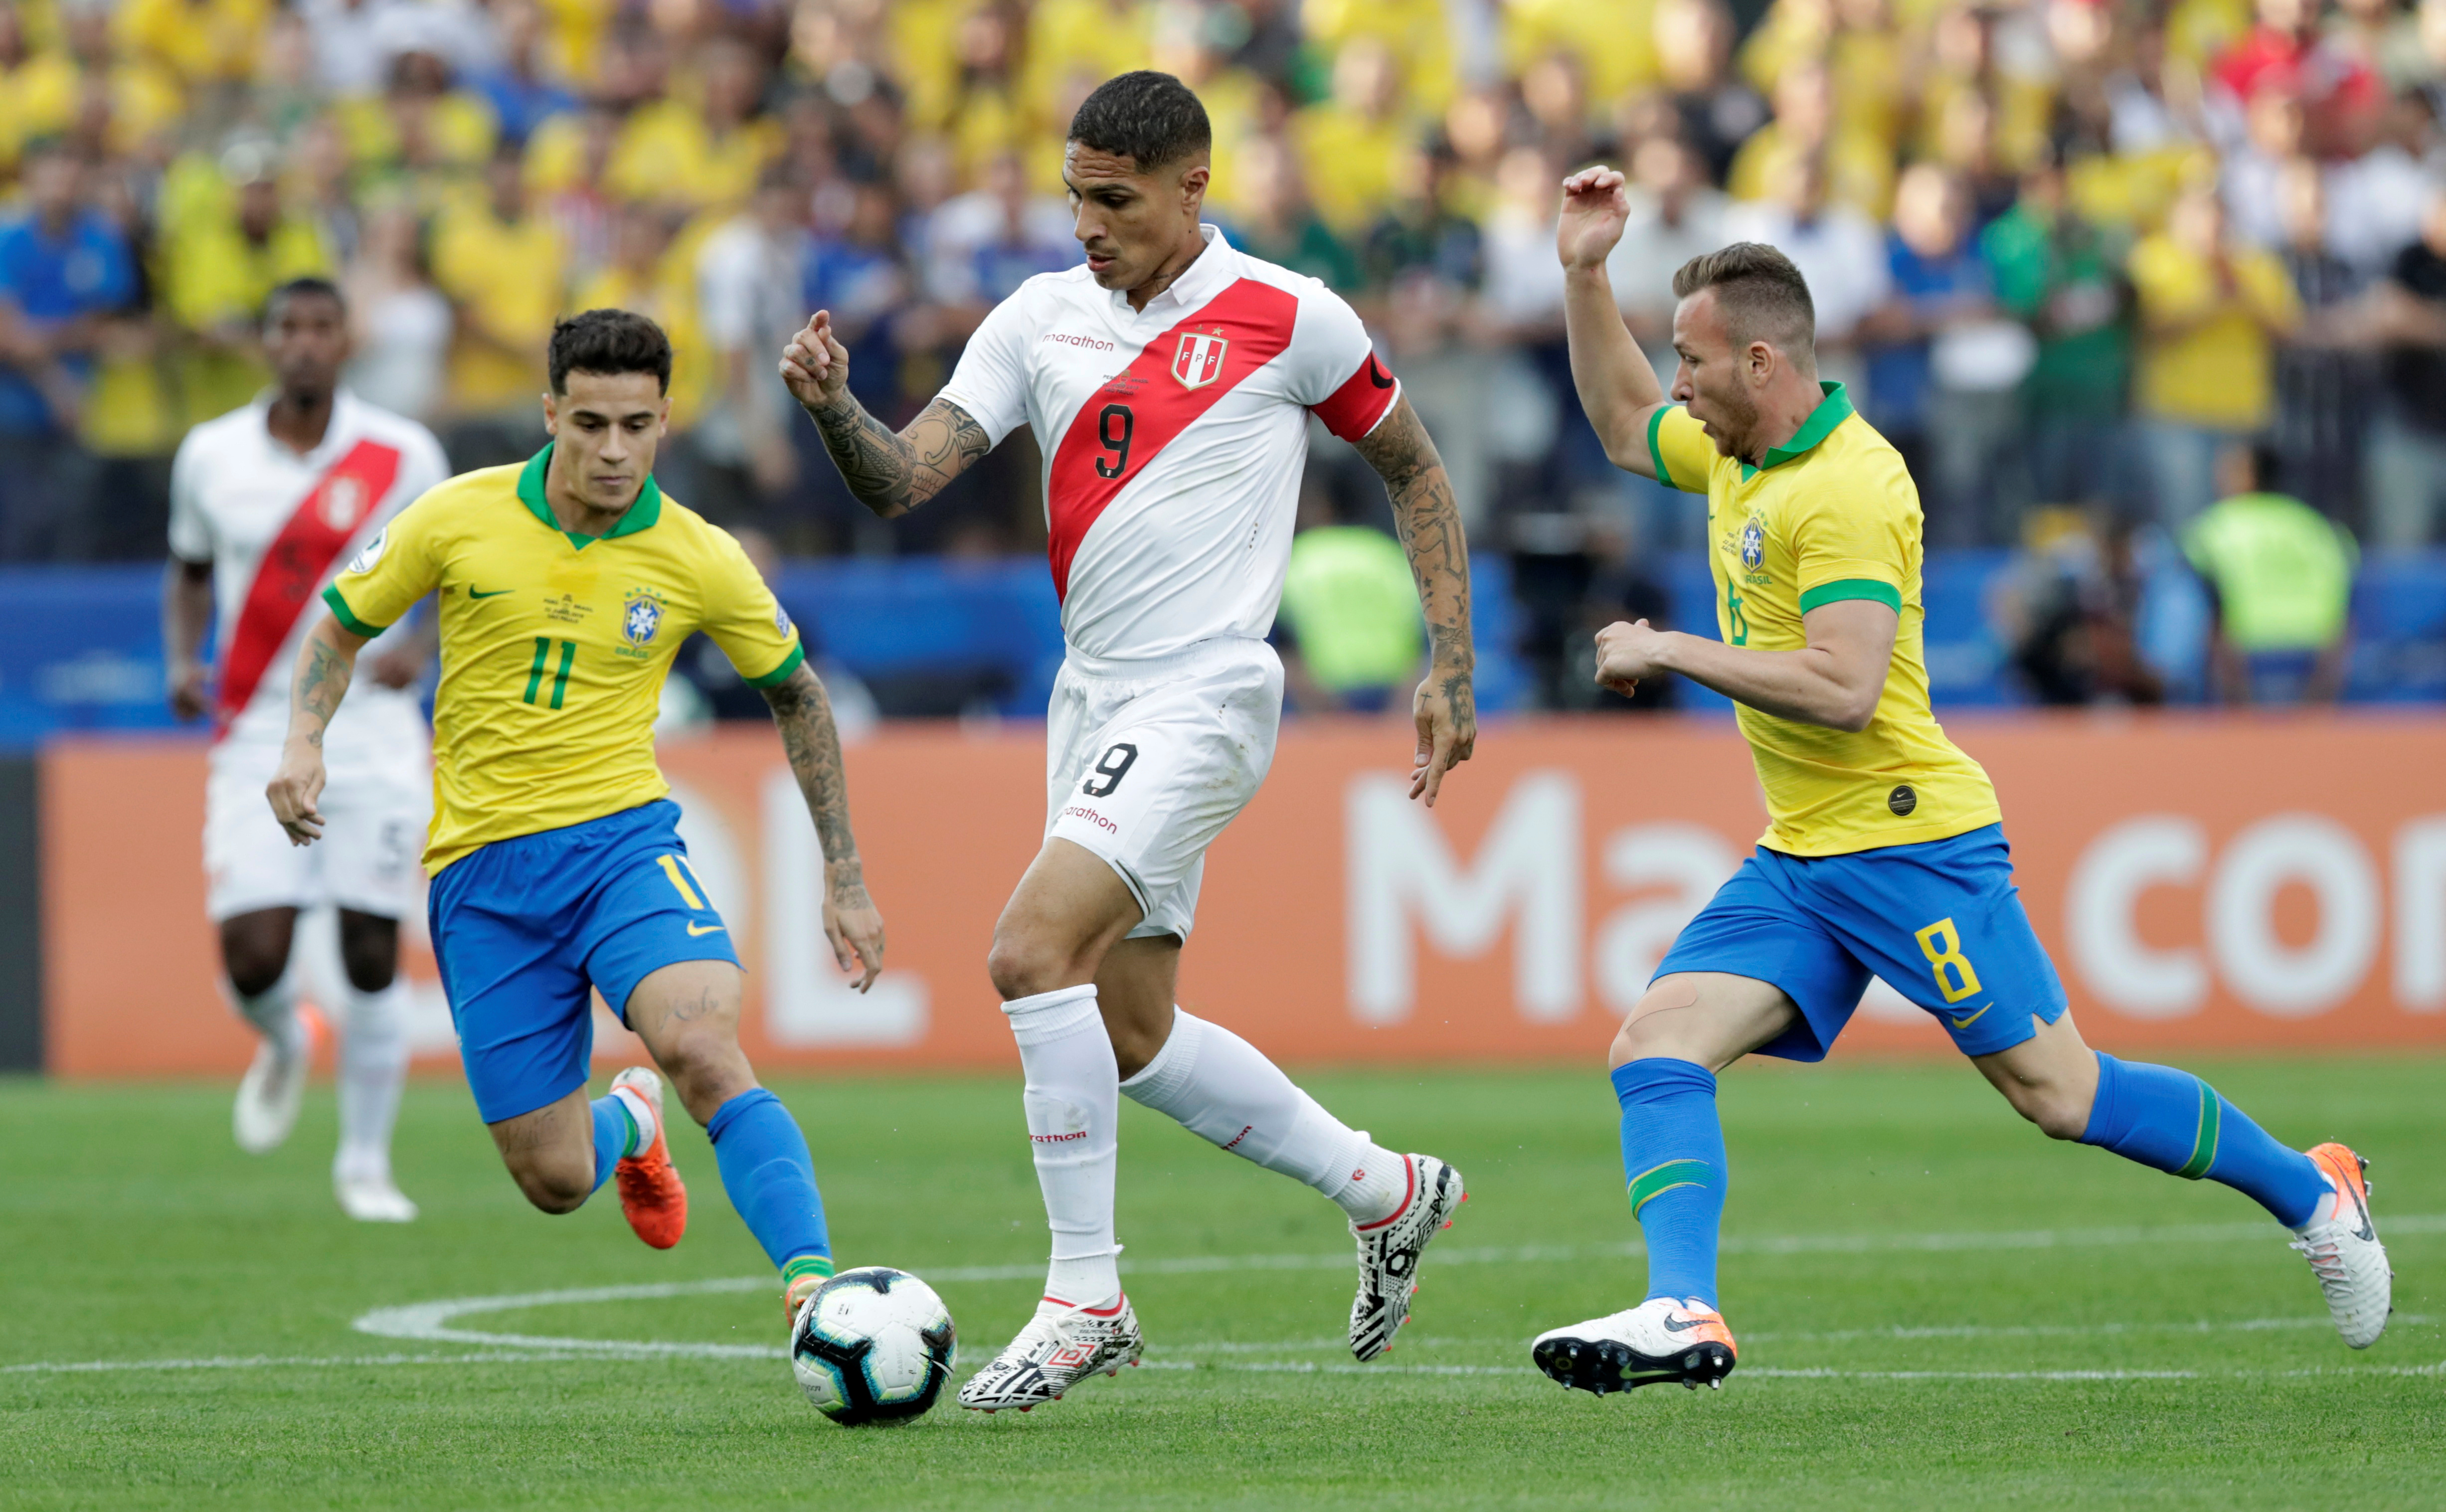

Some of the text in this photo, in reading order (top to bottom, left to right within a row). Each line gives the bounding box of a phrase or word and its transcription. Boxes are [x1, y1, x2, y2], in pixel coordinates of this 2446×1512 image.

[1043, 334, 1114, 351] marathon
[1096, 403, 1134, 479] 9
[524, 637, 575, 709] 11
[1083, 742, 1138, 798] 9
[1915, 917, 1982, 1004] 8
[1030, 1131, 1086, 1142] rathon
